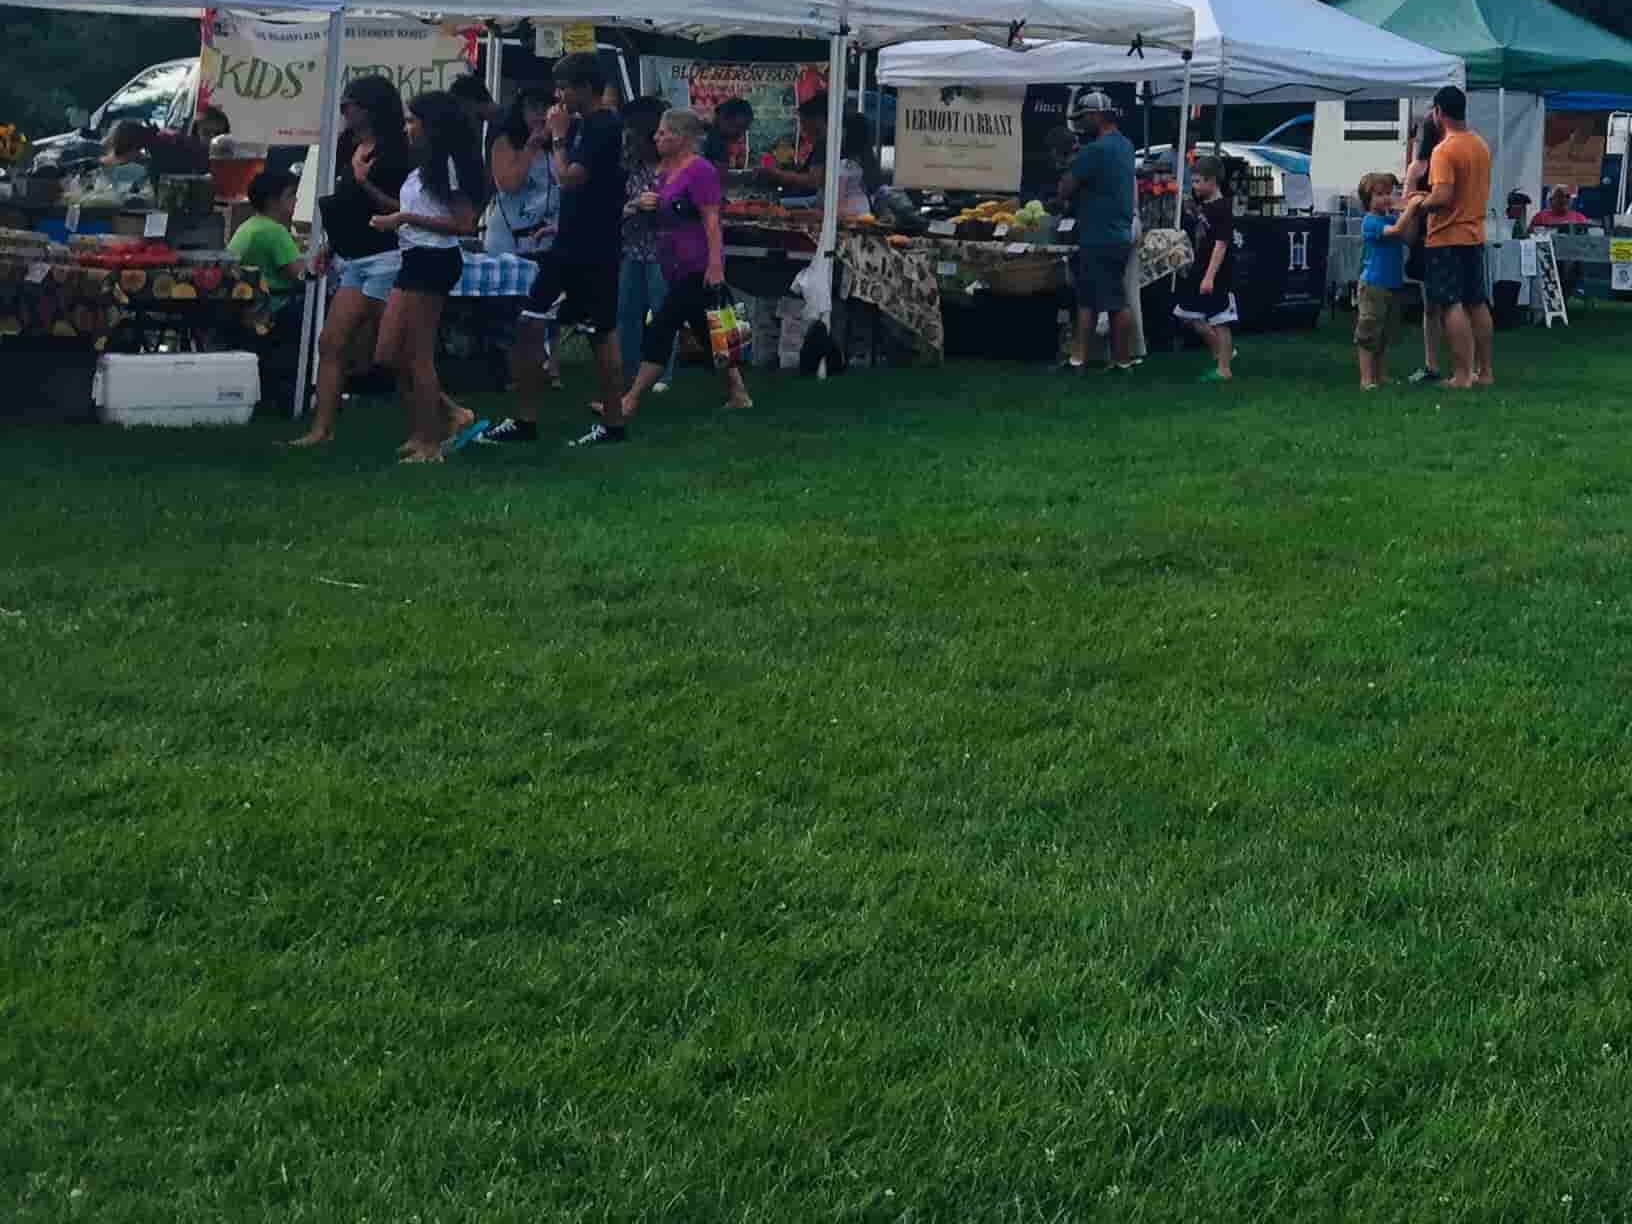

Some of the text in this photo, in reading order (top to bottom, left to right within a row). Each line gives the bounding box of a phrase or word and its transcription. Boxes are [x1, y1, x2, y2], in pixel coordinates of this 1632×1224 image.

[217, 55, 317, 100] KIDS'
[904, 108, 1013, 137] VERMONT CURRANT
